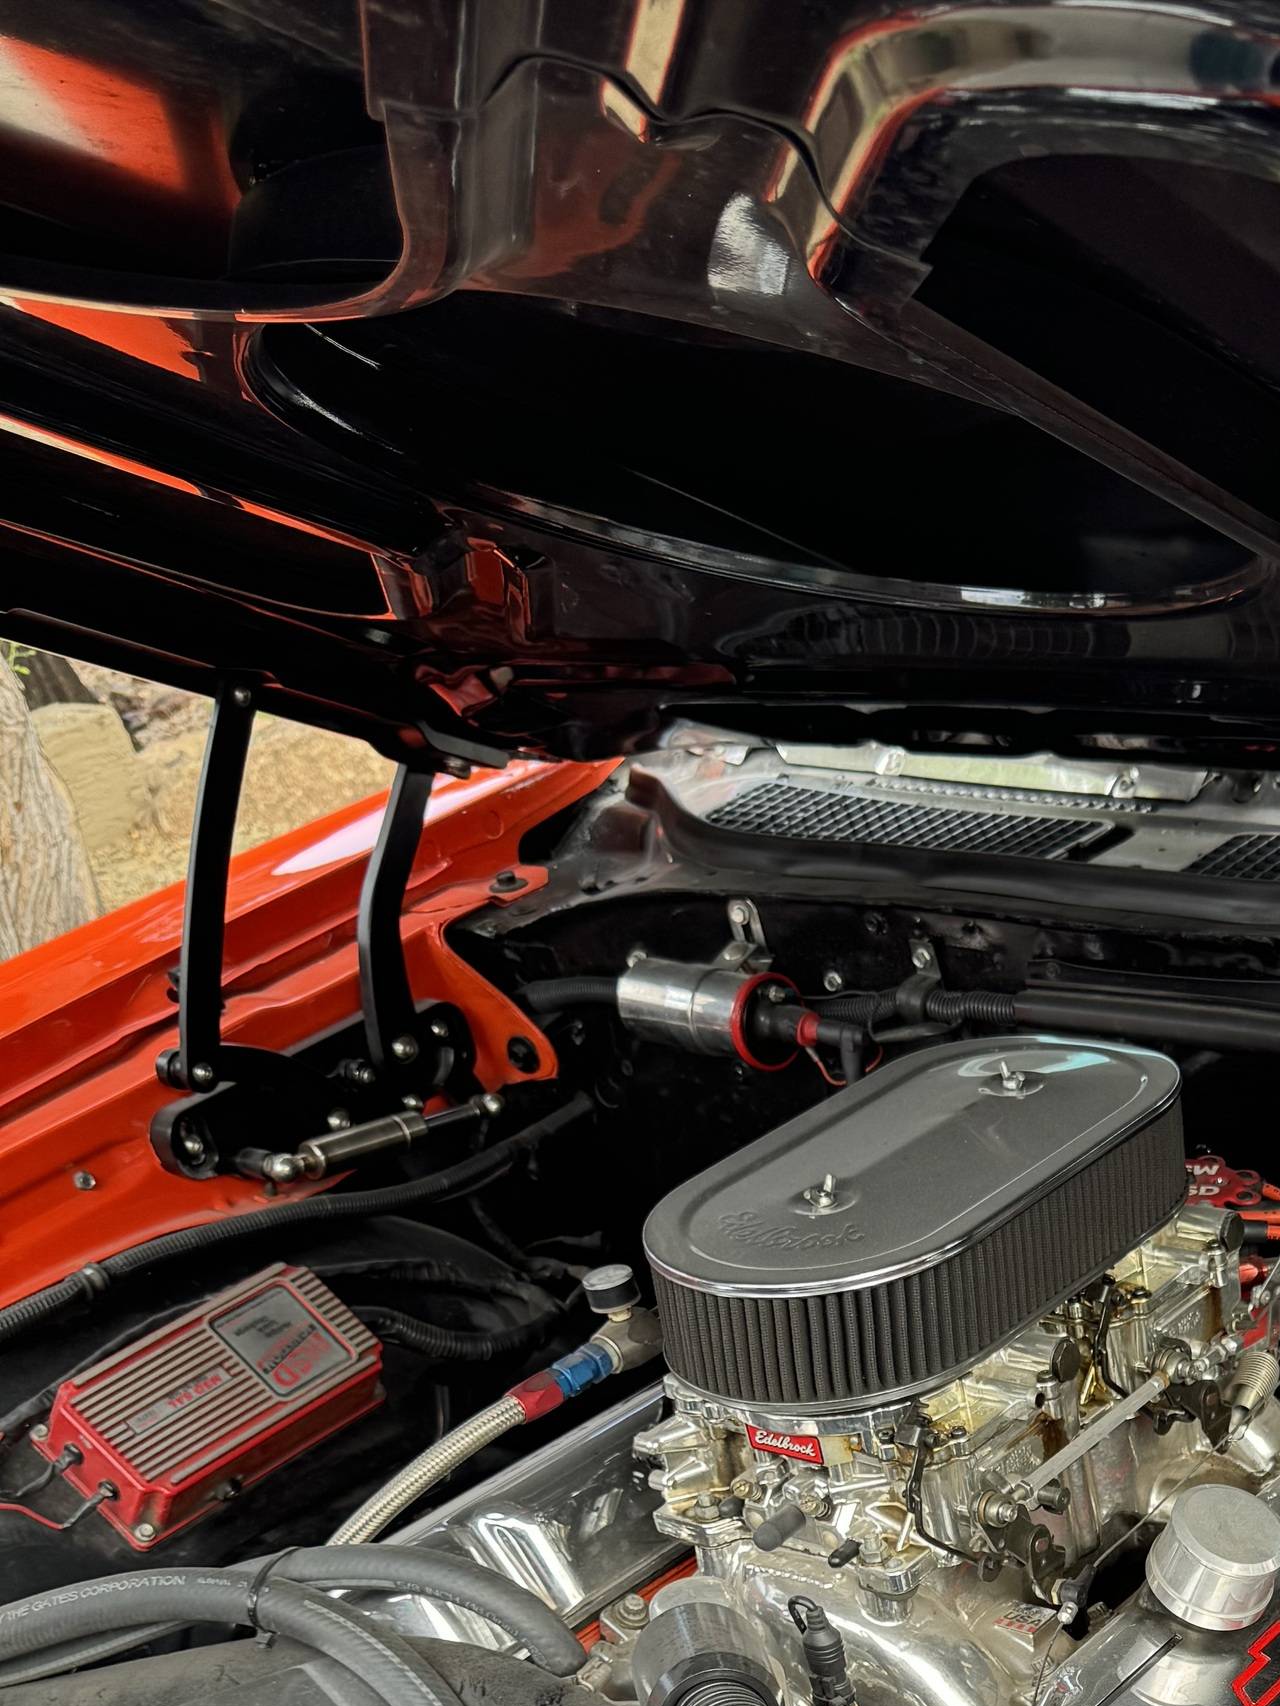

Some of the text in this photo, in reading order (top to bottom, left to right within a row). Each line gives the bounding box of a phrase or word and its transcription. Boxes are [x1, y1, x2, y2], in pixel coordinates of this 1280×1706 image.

[755, 1430, 816, 1457] Edelbrock
[31, 1590, 79, 1612] GATES
[80, 1574, 187, 1599] CORPORATION
[1003, 1610, 1041, 1626] USA
